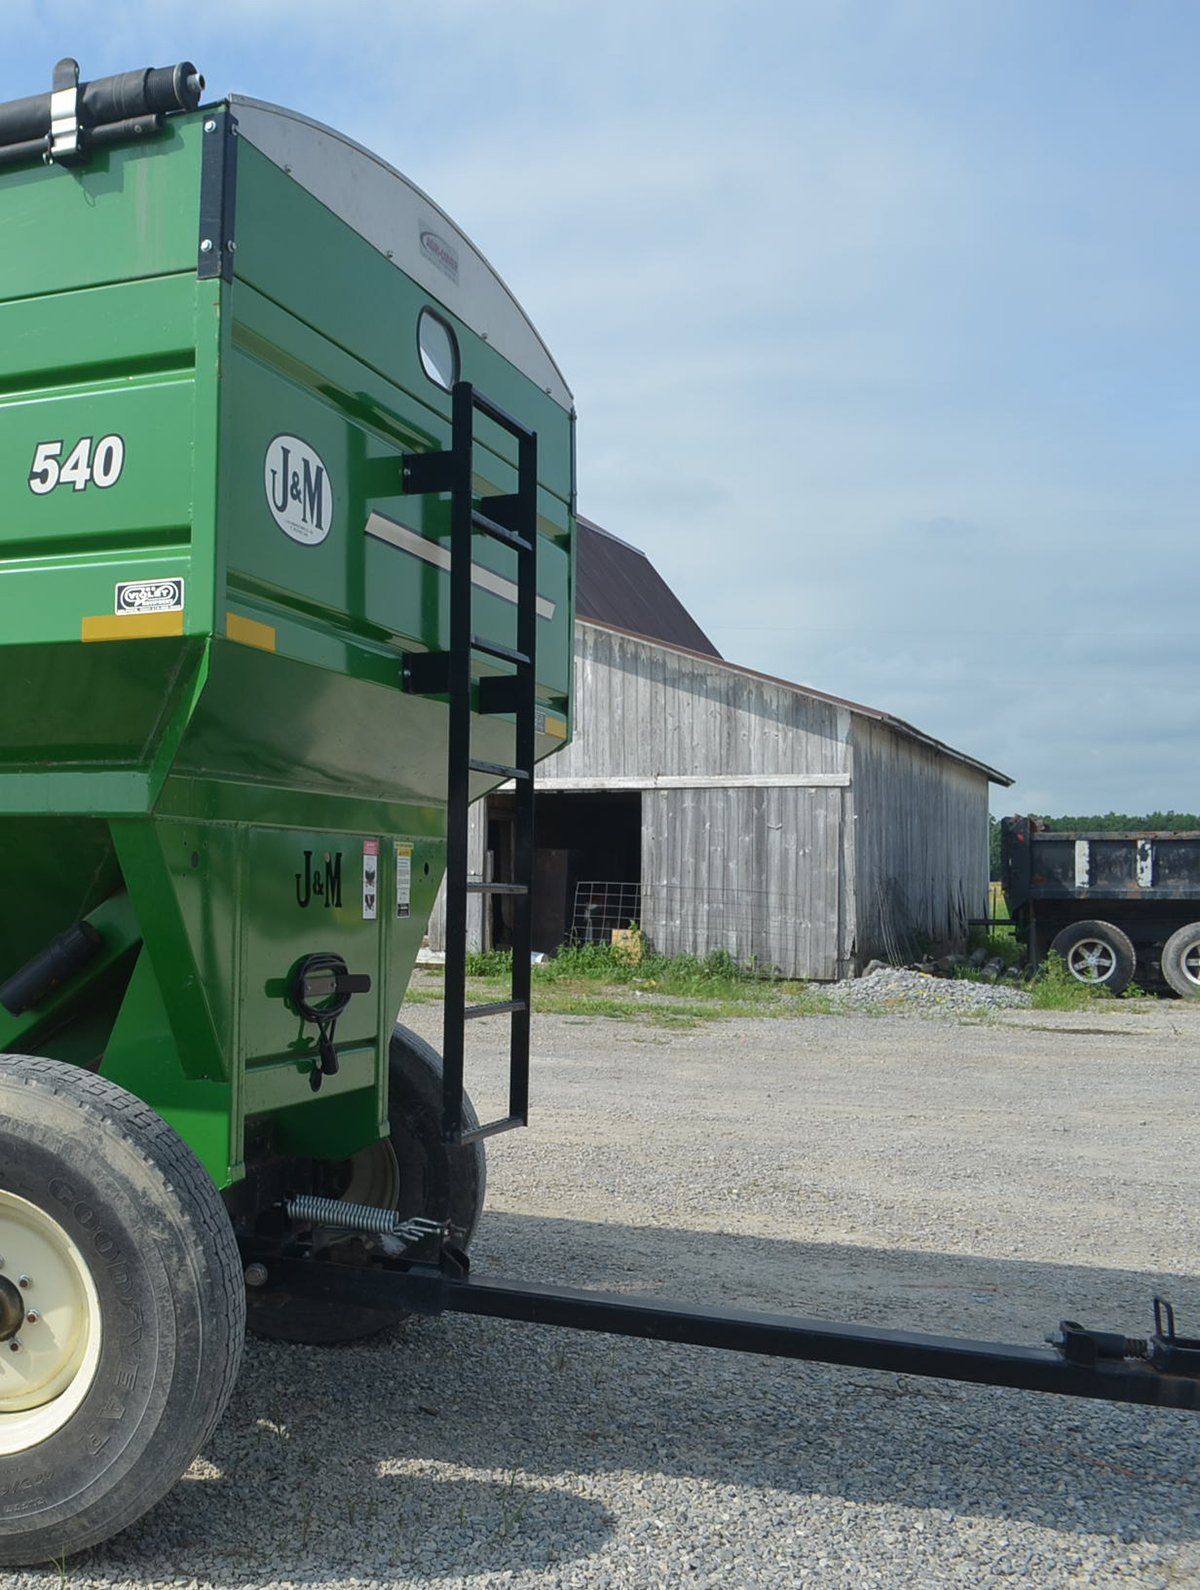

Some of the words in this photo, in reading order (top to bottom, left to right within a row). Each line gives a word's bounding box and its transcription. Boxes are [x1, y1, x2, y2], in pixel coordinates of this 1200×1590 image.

[27, 433, 125, 495] 540
[270, 446, 324, 531] J&M
[295, 850, 343, 908] J&M
[49, 1176, 144, 1456] GOODYEAR
